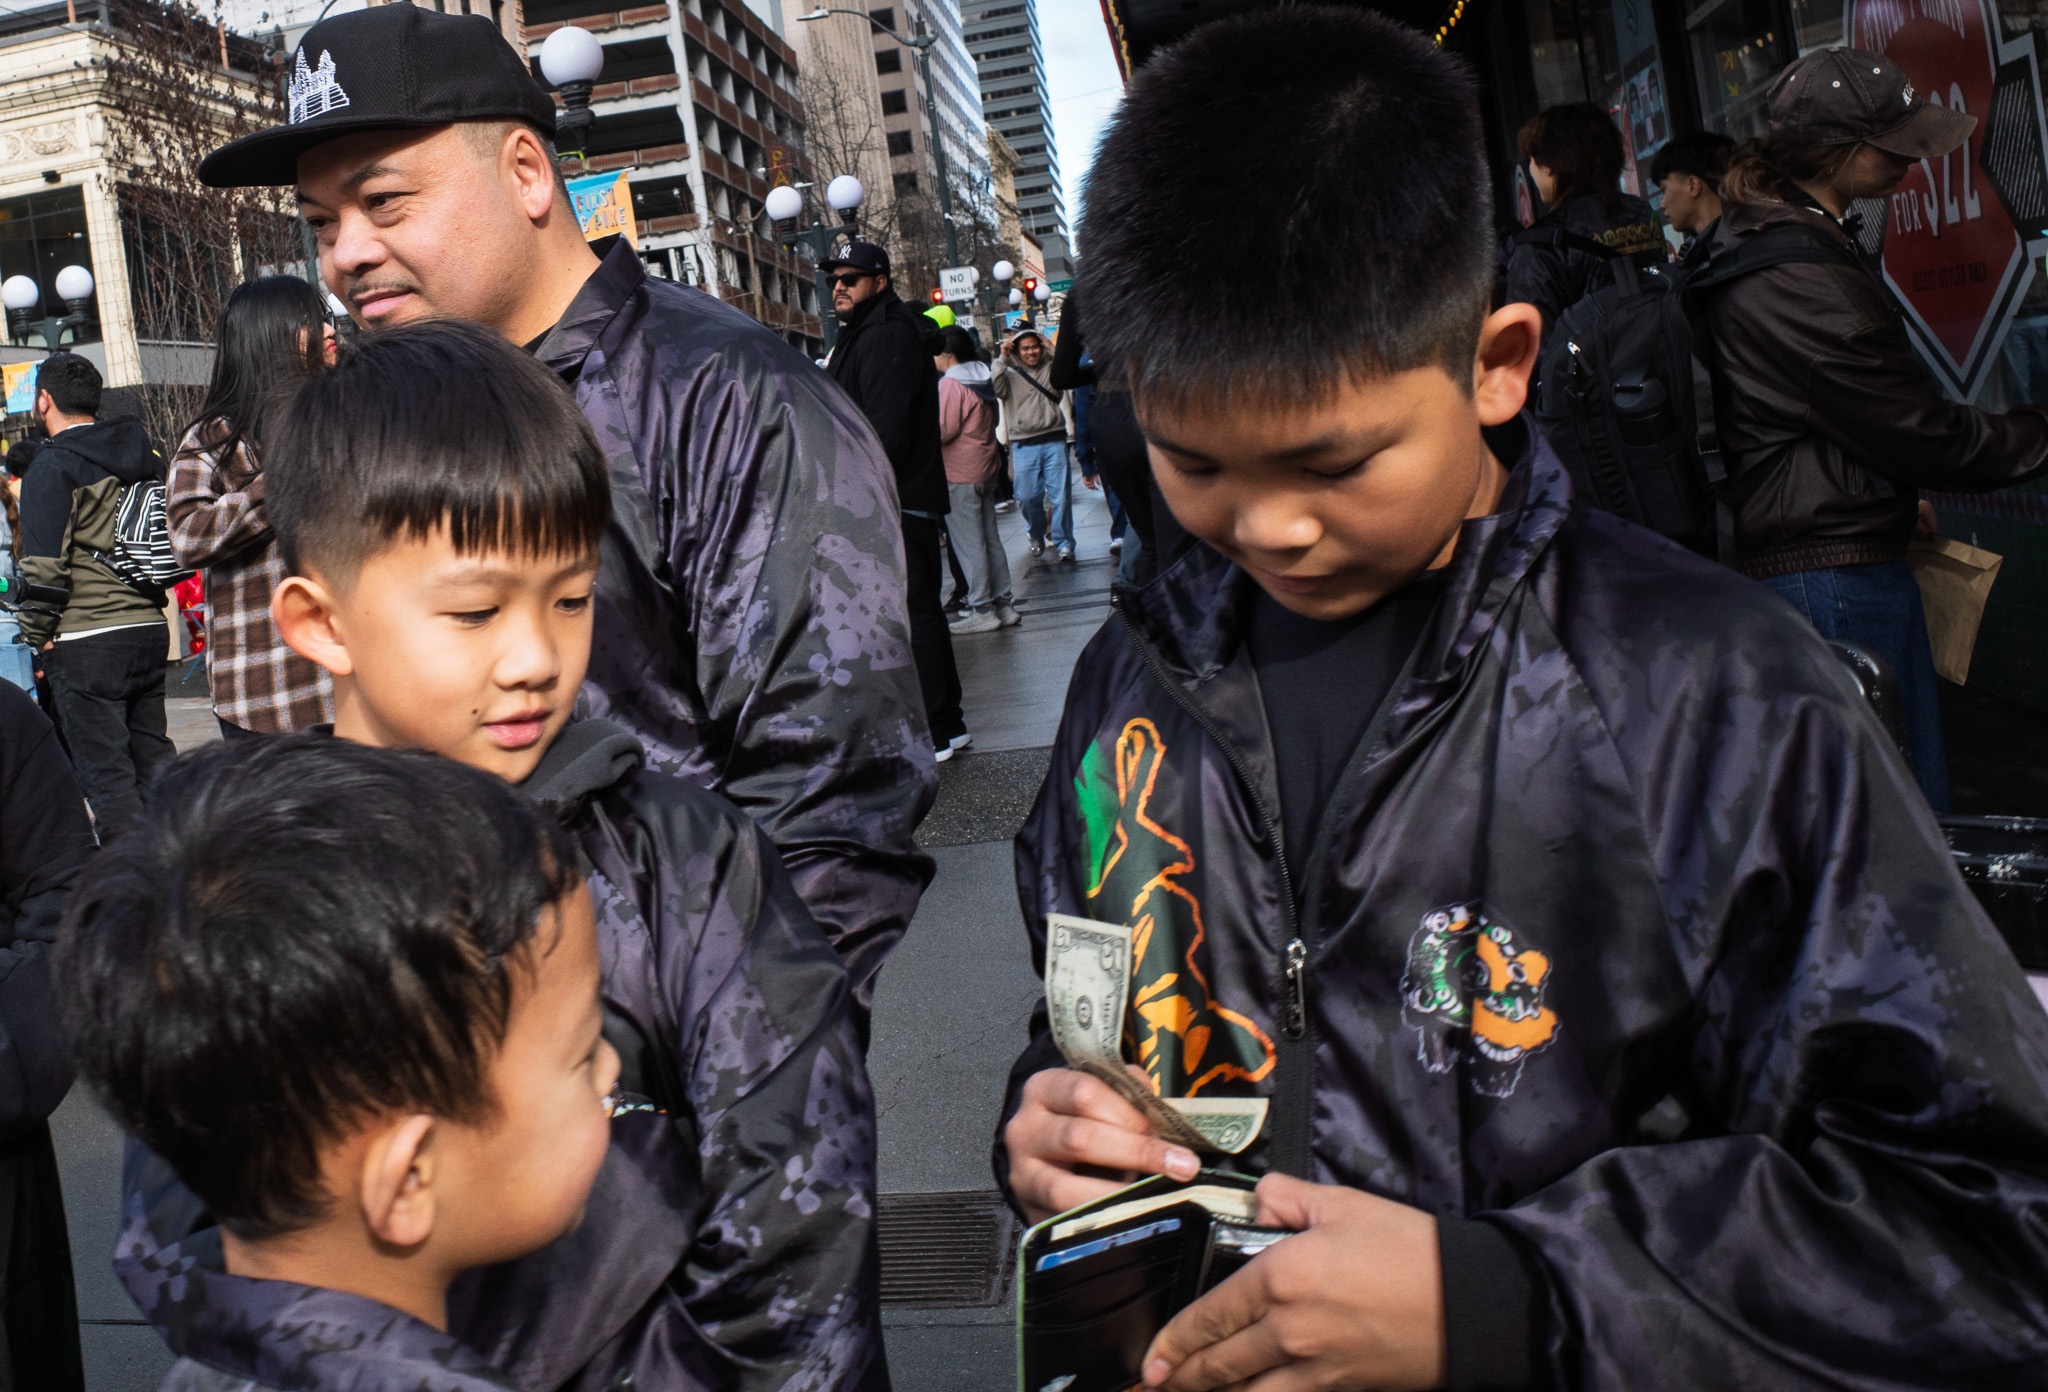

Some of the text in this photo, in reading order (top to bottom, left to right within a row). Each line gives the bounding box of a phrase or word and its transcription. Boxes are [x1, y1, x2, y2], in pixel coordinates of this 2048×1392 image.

[575, 188, 616, 213] FIRST
[593, 207, 627, 231] PIKE
[1892, 189, 1923, 236] FOR
[839, 244, 851, 259] NY
[950, 273, 964, 284] NO
[944, 286, 973, 297] TURNS
